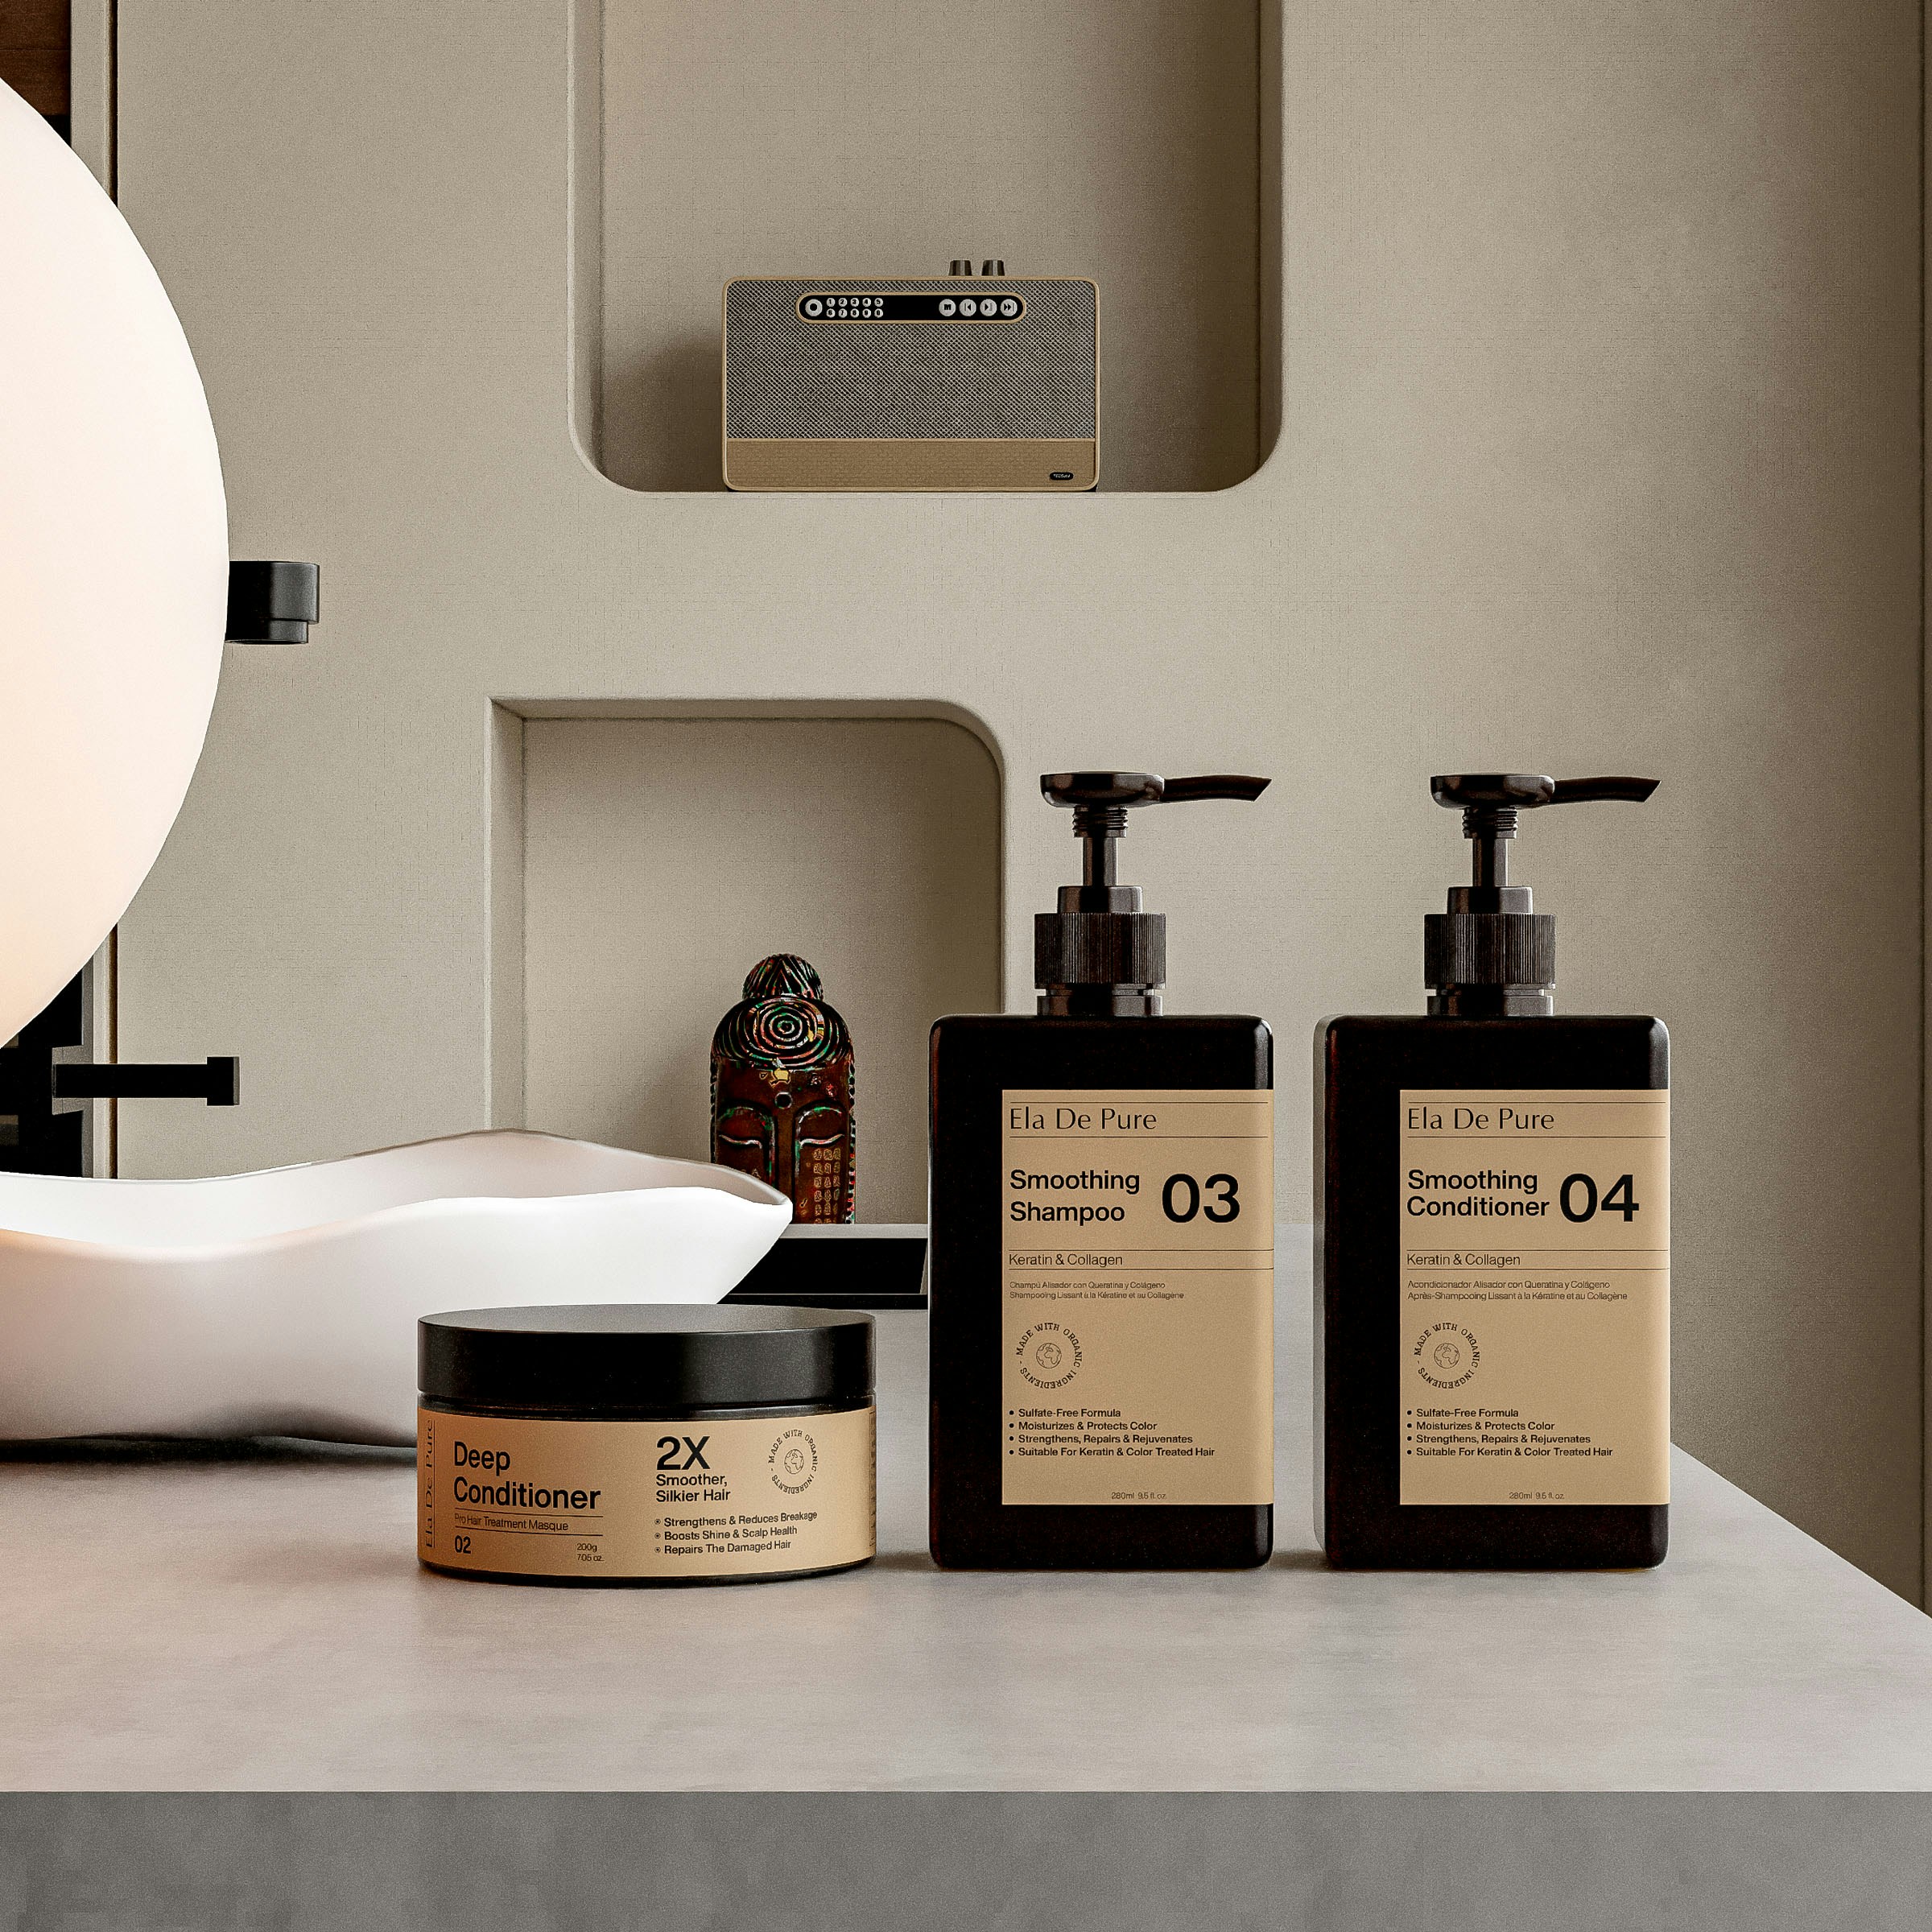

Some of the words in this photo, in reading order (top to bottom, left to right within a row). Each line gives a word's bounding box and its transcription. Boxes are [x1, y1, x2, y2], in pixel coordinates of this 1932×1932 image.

[1011, 1107, 1044, 1129] Ela
[1057, 1108, 1091, 1129] De
[1102, 1108, 1156, 1129] Pure
[1409, 1107, 1443, 1129] Ela
[1455, 1108, 1488, 1129] De
[1500, 1108, 1554, 1129] Pure
[1010, 1170, 1139, 1195] Smoothing
[1408, 1170, 1537, 1195] Smoothing
[1162, 1174, 1240, 1223] 03
[1407, 1196, 1550, 1216] Conditioner
[1560, 1174, 1639, 1223] 04
[1010, 1201, 1125, 1226] Shampoo
[1009, 1254, 1052, 1265] Keratin
[1055, 1254, 1064, 1265] &
[1067, 1254, 1122, 1267] Collagen
[1407, 1254, 1450, 1265] Keratin
[1453, 1254, 1462, 1265] &
[1465, 1253, 1520, 1268] Collagen
[1009, 1291, 1056, 1300] Shampooing
[1408, 1292, 1486, 1301] Après-Shampooing
[1587, 1292, 1627, 1302] Collagène
[1034, 1323, 1060, 1331] WITH
[1433, 1323, 1458, 1331] WITH
[1016, 1330, 1034, 1356] MADE
[1063, 1328, 1083, 1368] ORGANIC
[1414, 1330, 1432, 1356] MADE
[1461, 1328, 1480, 1368] ORGANIC
[1020, 1368, 1077, 1389] INGREDIENTS
[1418, 1368, 1475, 1389] INGREDIENTS
[1018, 1409, 1079, 1417] Sulfate-Free
[1081, 1409, 1121, 1417] Formula
[1417, 1409, 1476, 1417] Sulfate-Free
[1479, 1409, 1518, 1417] Formula
[782, 1429, 803, 1439] WITH
[1019, 1422, 1074, 1430] Moisturizes
[1077, 1422, 1084, 1430] &
[1088, 1422, 1128, 1430] Protects
[1130, 1422, 1158, 1430] Color
[1417, 1422, 1472, 1430] Moisturizes
[1475, 1422, 1482, 1430] &
[1485, 1422, 1525, 1430] Protects
[1528, 1422, 1555, 1430] Color
[1018, 1435, 1081, 1445] Strengthens,
[1084, 1435, 1121, 1445] Repairs
[1123, 1435, 1130, 1443] &
[1133, 1435, 1192, 1445] Rejuvenates
[1417, 1435, 1479, 1445] Strengthens,
[1482, 1435, 1518, 1445] Repairs
[1521, 1435, 1527, 1443] &
[1531, 1435, 1591, 1445] Rejuvenates
[455, 1441, 510, 1476] Deep
[657, 1436, 710, 1470] 2X
[769, 1438, 782, 1462] MADE
[804, 1433, 819, 1472] ORGANIC
[1018, 1447, 1058, 1455] Suitable
[1061, 1447, 1077, 1455] For
[1080, 1447, 1113, 1455] Keratin
[1117, 1447, 1124, 1455] &
[1126, 1447, 1153, 1455] Color
[1155, 1447, 1192, 1456] Treated
[1195, 1447, 1215, 1456] Hair
[1417, 1447, 1455, 1455] Suitable
[1459, 1447, 1475, 1455] For
[1477, 1447, 1512, 1455] Keratin
[1514, 1447, 1521, 1455] &
[1524, 1447, 1550, 1455] Color
[1554, 1447, 1591, 1456] Treated
[1594, 1447, 1612, 1456] Hair
[656, 1473, 727, 1488] Smoother,
[771, 1473, 815, 1494] INGREDIENTS
[454, 1476, 601, 1509] Conditioner
[656, 1490, 700, 1502] Silkier
[704, 1488, 730, 1501] Hair
[468, 1515, 481, 1526] Hair
[483, 1517, 526, 1529] Treatment
[529, 1520, 568, 1531] Masque
[664, 1516, 726, 1527] Strengthens
[729, 1515, 737, 1525] &
[739, 1513, 778, 1524] Reduces
[781, 1510, 818, 1522] Breakage
[664, 1530, 700, 1541] Boosts
[703, 1530, 730, 1540] Shine
[733, 1529, 740, 1539] &
[742, 1527, 767, 1539] Scalp
[770, 1525, 797, 1537] Health
[454, 1536, 471, 1554] 02
[577, 1543, 597, 1554] 200g
[664, 1545, 703, 1556] Repairs
[706, 1544, 724, 1554] The
[727, 1541, 772, 1554] Damaged
[774, 1540, 791, 1550] Hair
